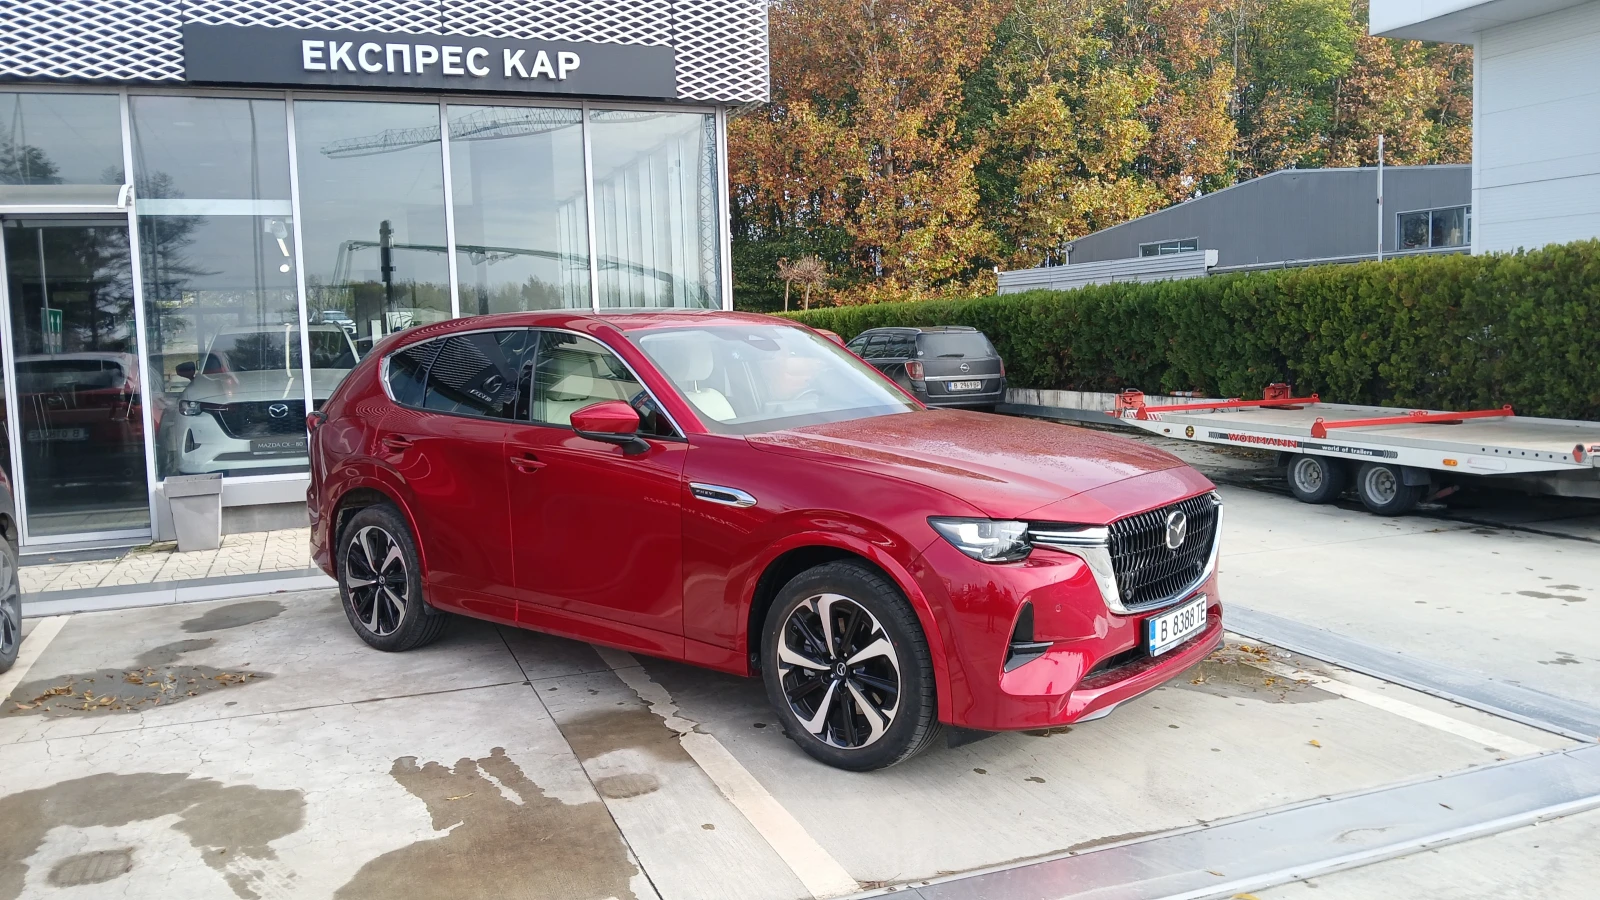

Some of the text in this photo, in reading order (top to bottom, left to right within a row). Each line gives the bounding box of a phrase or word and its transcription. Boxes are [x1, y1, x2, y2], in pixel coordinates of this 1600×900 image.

[302, 39, 581, 80] ЕКСПРЕС КАР
[1227, 433, 1298, 449] WÖRMANN
[1351, 447, 1373, 456] trailers
[1161, 600, 1206, 642] B 8388 TE
